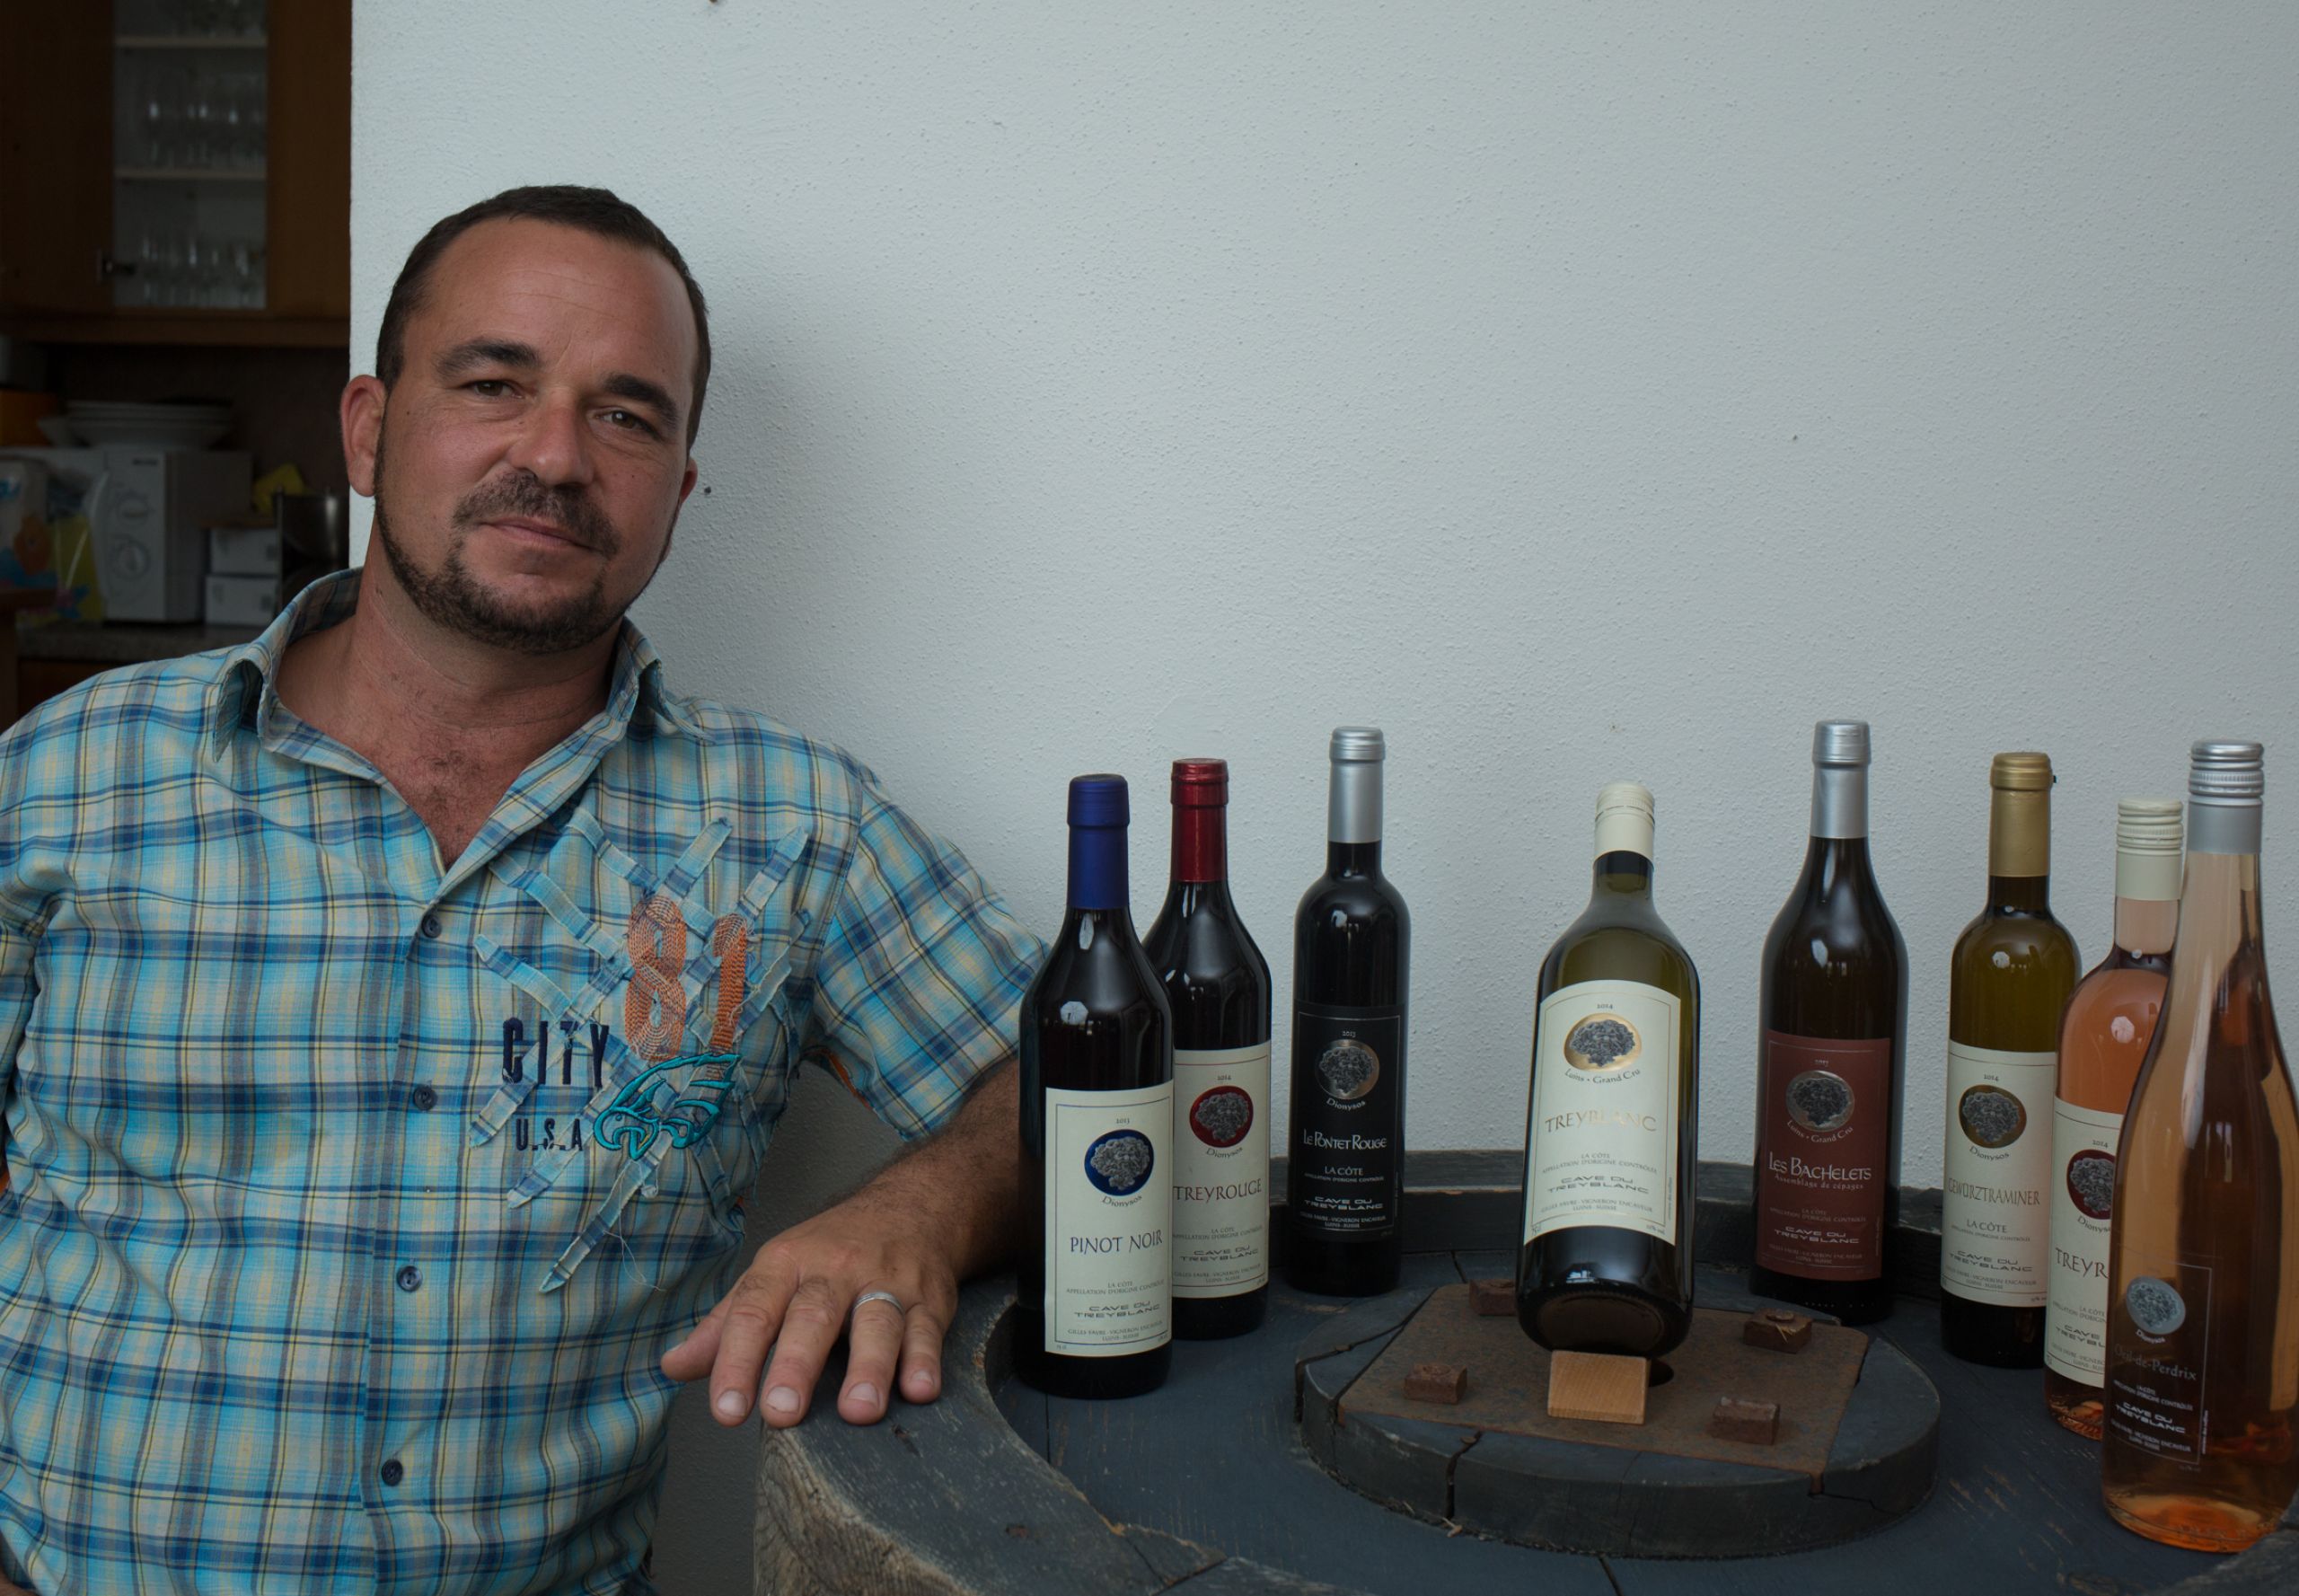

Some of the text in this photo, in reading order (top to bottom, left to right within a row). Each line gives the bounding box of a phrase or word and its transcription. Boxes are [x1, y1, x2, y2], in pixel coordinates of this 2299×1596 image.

[625, 895, 747, 1062] 81
[503, 1018, 610, 1089] CITY
[1564, 1068, 1641, 1084] Luins Grand Cru
[1984, 1073, 1999, 1081] 2014
[1326, 1098, 1366, 1111] Dionysos
[1545, 1109, 1657, 1133] TREYBLANC
[1787, 1120, 1854, 1143] Luins Grand Cru
[1352, 1134, 1387, 1151] ROUGE
[2092, 1139, 2108, 1148] 2014
[1206, 1147, 1243, 1158] Dionysos
[1969, 1145, 2010, 1160] Dionysos
[1325, 1166, 1364, 1176] LA CÔTE
[1790, 1157, 1872, 1181] BACHELETS
[1561, 1175, 1604, 1184] CAVE
[1775, 1174, 1818, 1189] Assemblage
[1833, 1182, 1863, 1191] cépages
[1173, 1178, 1262, 1204] TREYROUGE
[1546, 1182, 1650, 1195] TREYBLANC
[1102, 1195, 1142, 1207] Dionysos
[1304, 1200, 1384, 1211] TREYBLANC
[1315, 1195, 1351, 1204] CAVE
[1785, 1226, 1822, 1236] CAVE
[1967, 1219, 1977, 1229] LA
[1978, 1221, 2007, 1233] CÔTE
[1070, 1229, 1163, 1255] PINOT NOIR
[1775, 1229, 1860, 1244] TREYBLANC
[1179, 1248, 1258, 1262] TREYBLANC
[1235, 1245, 1250, 1253] DU
[1958, 1250, 1992, 1262] CAVE
[1949, 1253, 2034, 1272] TREYBLANC
[1074, 1304, 1161, 1318] TREYBLANC
[1089, 1301, 1150, 1311] CAVE DU
[2065, 1325, 2100, 1340] CAVE
[2115, 1404, 2186, 1435] TREYBLANC
[2122, 1401, 2173, 1424] CAVE DU
